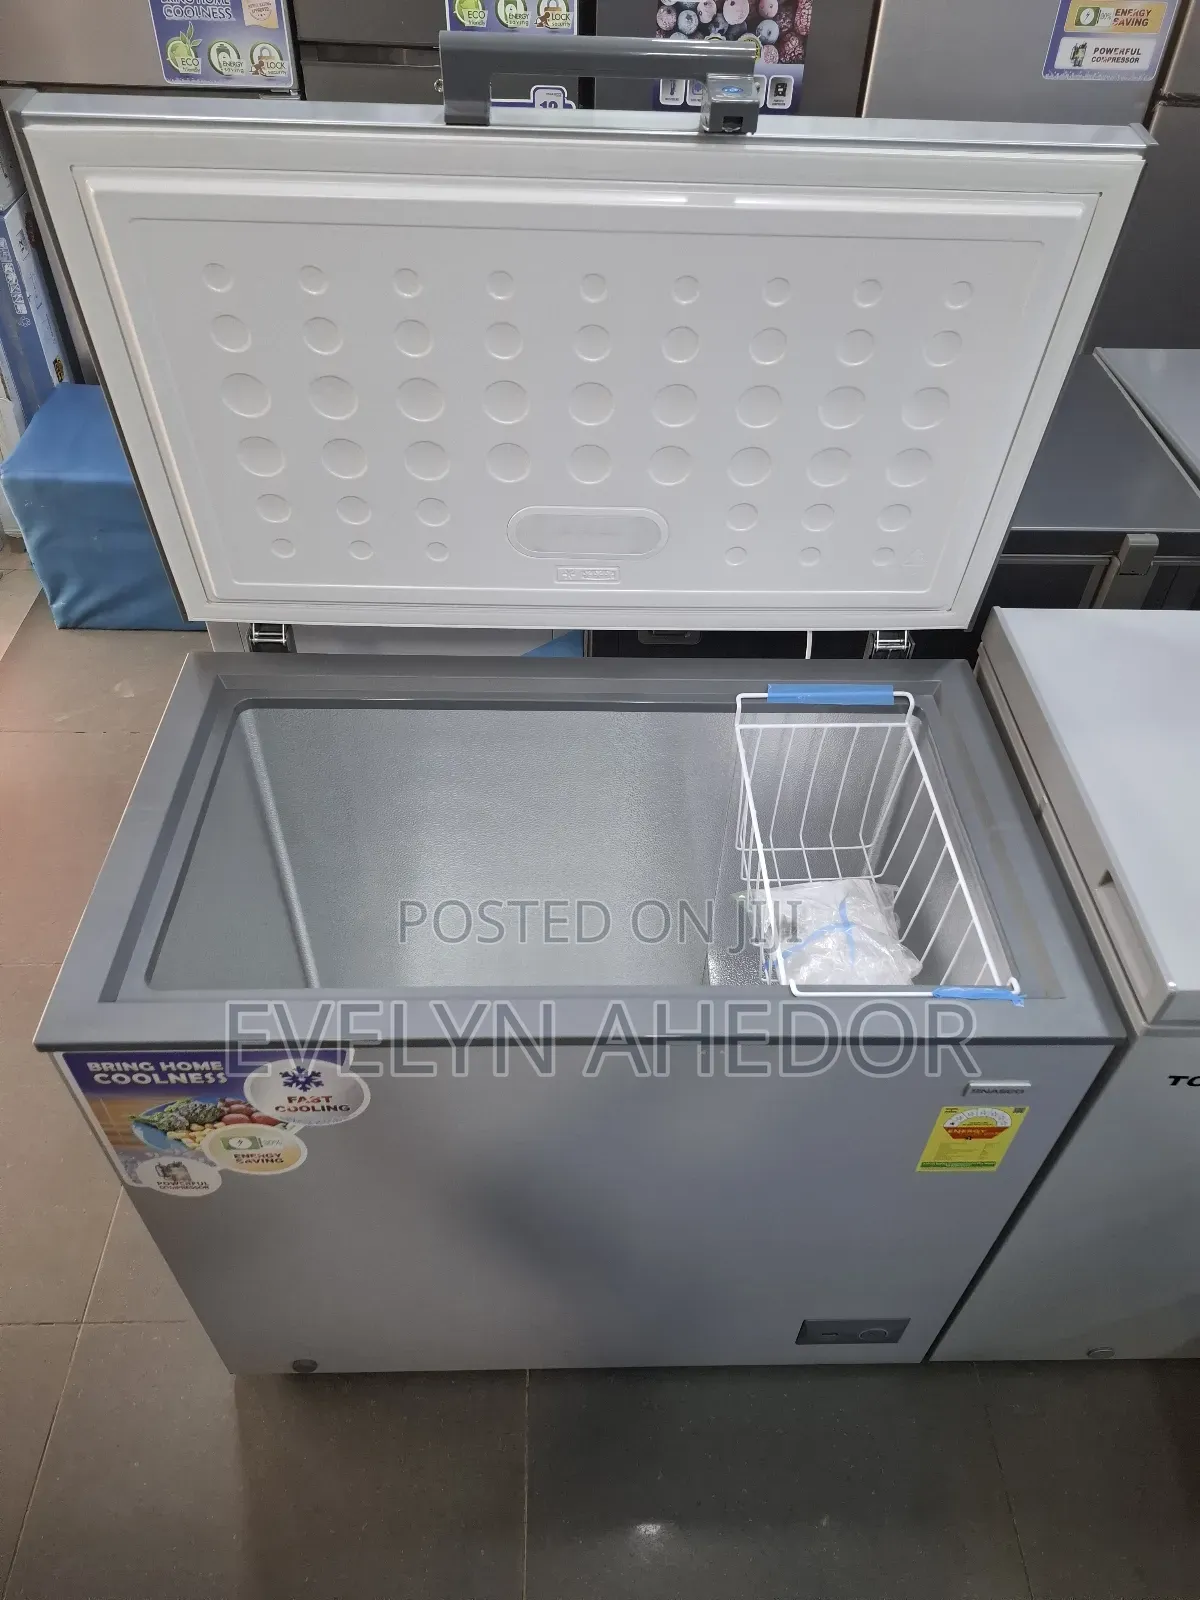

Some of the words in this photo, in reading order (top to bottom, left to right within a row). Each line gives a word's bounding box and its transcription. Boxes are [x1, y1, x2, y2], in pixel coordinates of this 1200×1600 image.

[163, 5, 233, 19] COOLNESS
[467, 10, 486, 19] ECO
[508, 12, 530, 20] ENERGY
[1114, 8, 1152, 17] ENERGY
[551, 13, 571, 21] LOCK
[1112, 17, 1149, 27] SAVING
[1093, 47, 1142, 56] POWERFUL
[181, 58, 200, 67] ECO
[1091, 56, 1140, 64] COMPRESSOR
[266, 61, 286, 70] LOCK
[86, 1061, 155, 1072] BRING
[159, 1061, 224, 1071] HOME
[93, 1072, 228, 1085] COOLNESS
[286, 1095, 333, 1104] FAST
[274, 1104, 351, 1113] COOLING
